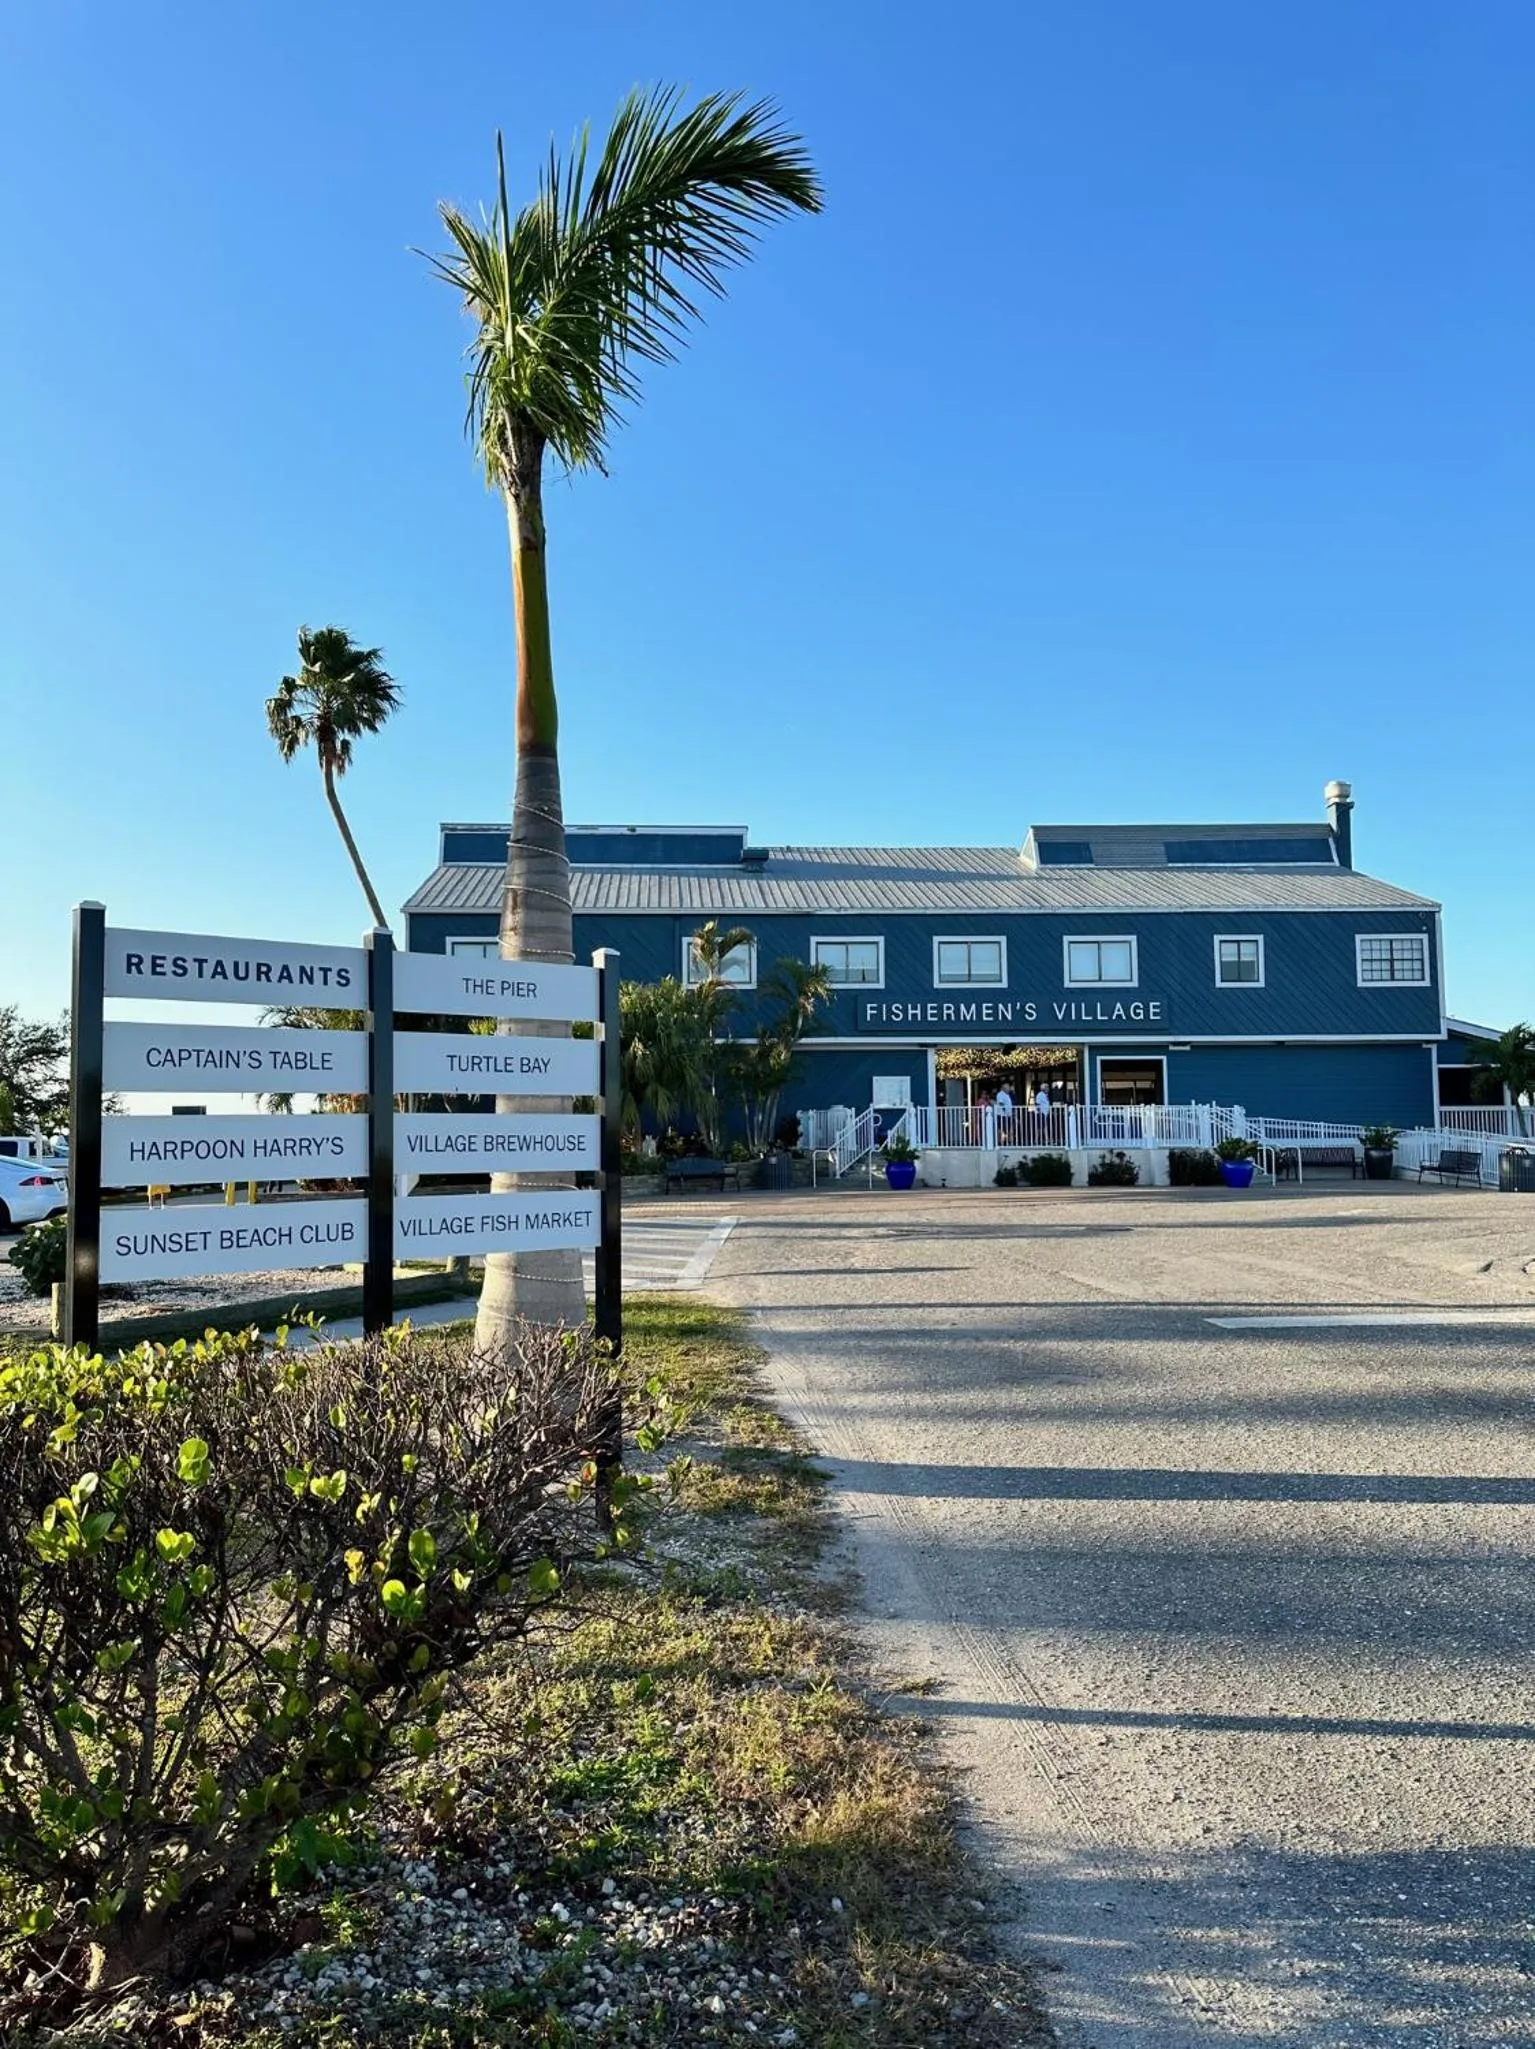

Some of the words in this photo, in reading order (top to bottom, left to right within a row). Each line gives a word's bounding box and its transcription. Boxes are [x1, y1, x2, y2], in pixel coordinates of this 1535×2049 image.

[126, 952, 351, 988] RESTAURANTS
[462, 977, 496, 996] THE
[500, 980, 537, 998] PIER
[866, 1002, 1037, 1022] FISHERMEN'S
[1052, 1001, 1161, 1020] VILLAGE
[146, 1047, 263, 1070] CAPTAIN'S
[268, 1050, 333, 1071] TABLE
[446, 1054, 514, 1073] TURTLE
[519, 1056, 551, 1074] BAY
[130, 1139, 245, 1162] HARPOON
[253, 1136, 344, 1158] HARRY'S
[406, 1134, 478, 1153] VILLAGE
[483, 1134, 586, 1153] BREWHOUSE
[399, 1216, 475, 1237] VILLAGE
[480, 1214, 519, 1233] FISH
[525, 1210, 593, 1230] MARKET
[115, 1231, 212, 1257] SUNSET
[220, 1226, 292, 1250] BEACH
[299, 1222, 355, 1244] CLUB
